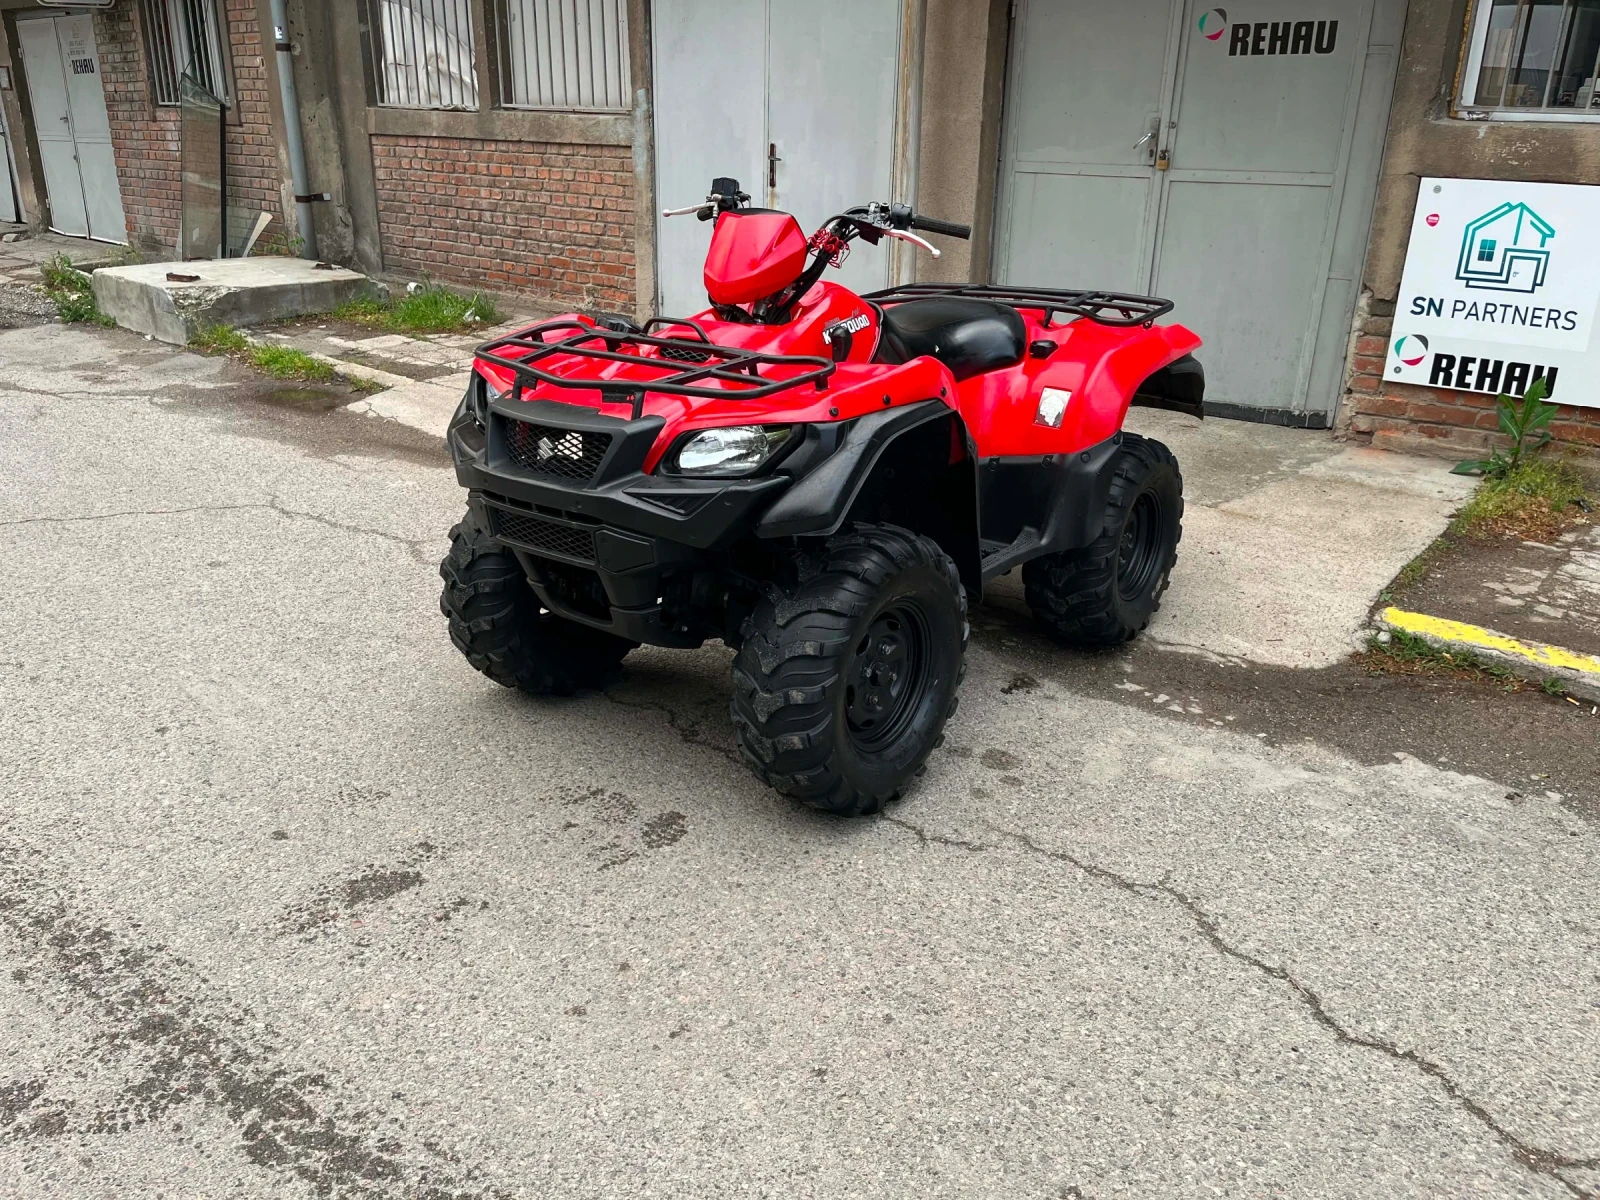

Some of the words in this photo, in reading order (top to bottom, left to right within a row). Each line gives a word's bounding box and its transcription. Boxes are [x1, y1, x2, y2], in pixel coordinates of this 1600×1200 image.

[1228, 20, 1339, 57] REHAU
[71, 58, 95, 75] REHAU
[822, 313, 870, 345] KQUAD
[1410, 296, 1444, 318] SN
[1450, 300, 1578, 331] PARTNERS
[1428, 352, 1559, 400] REHAU
